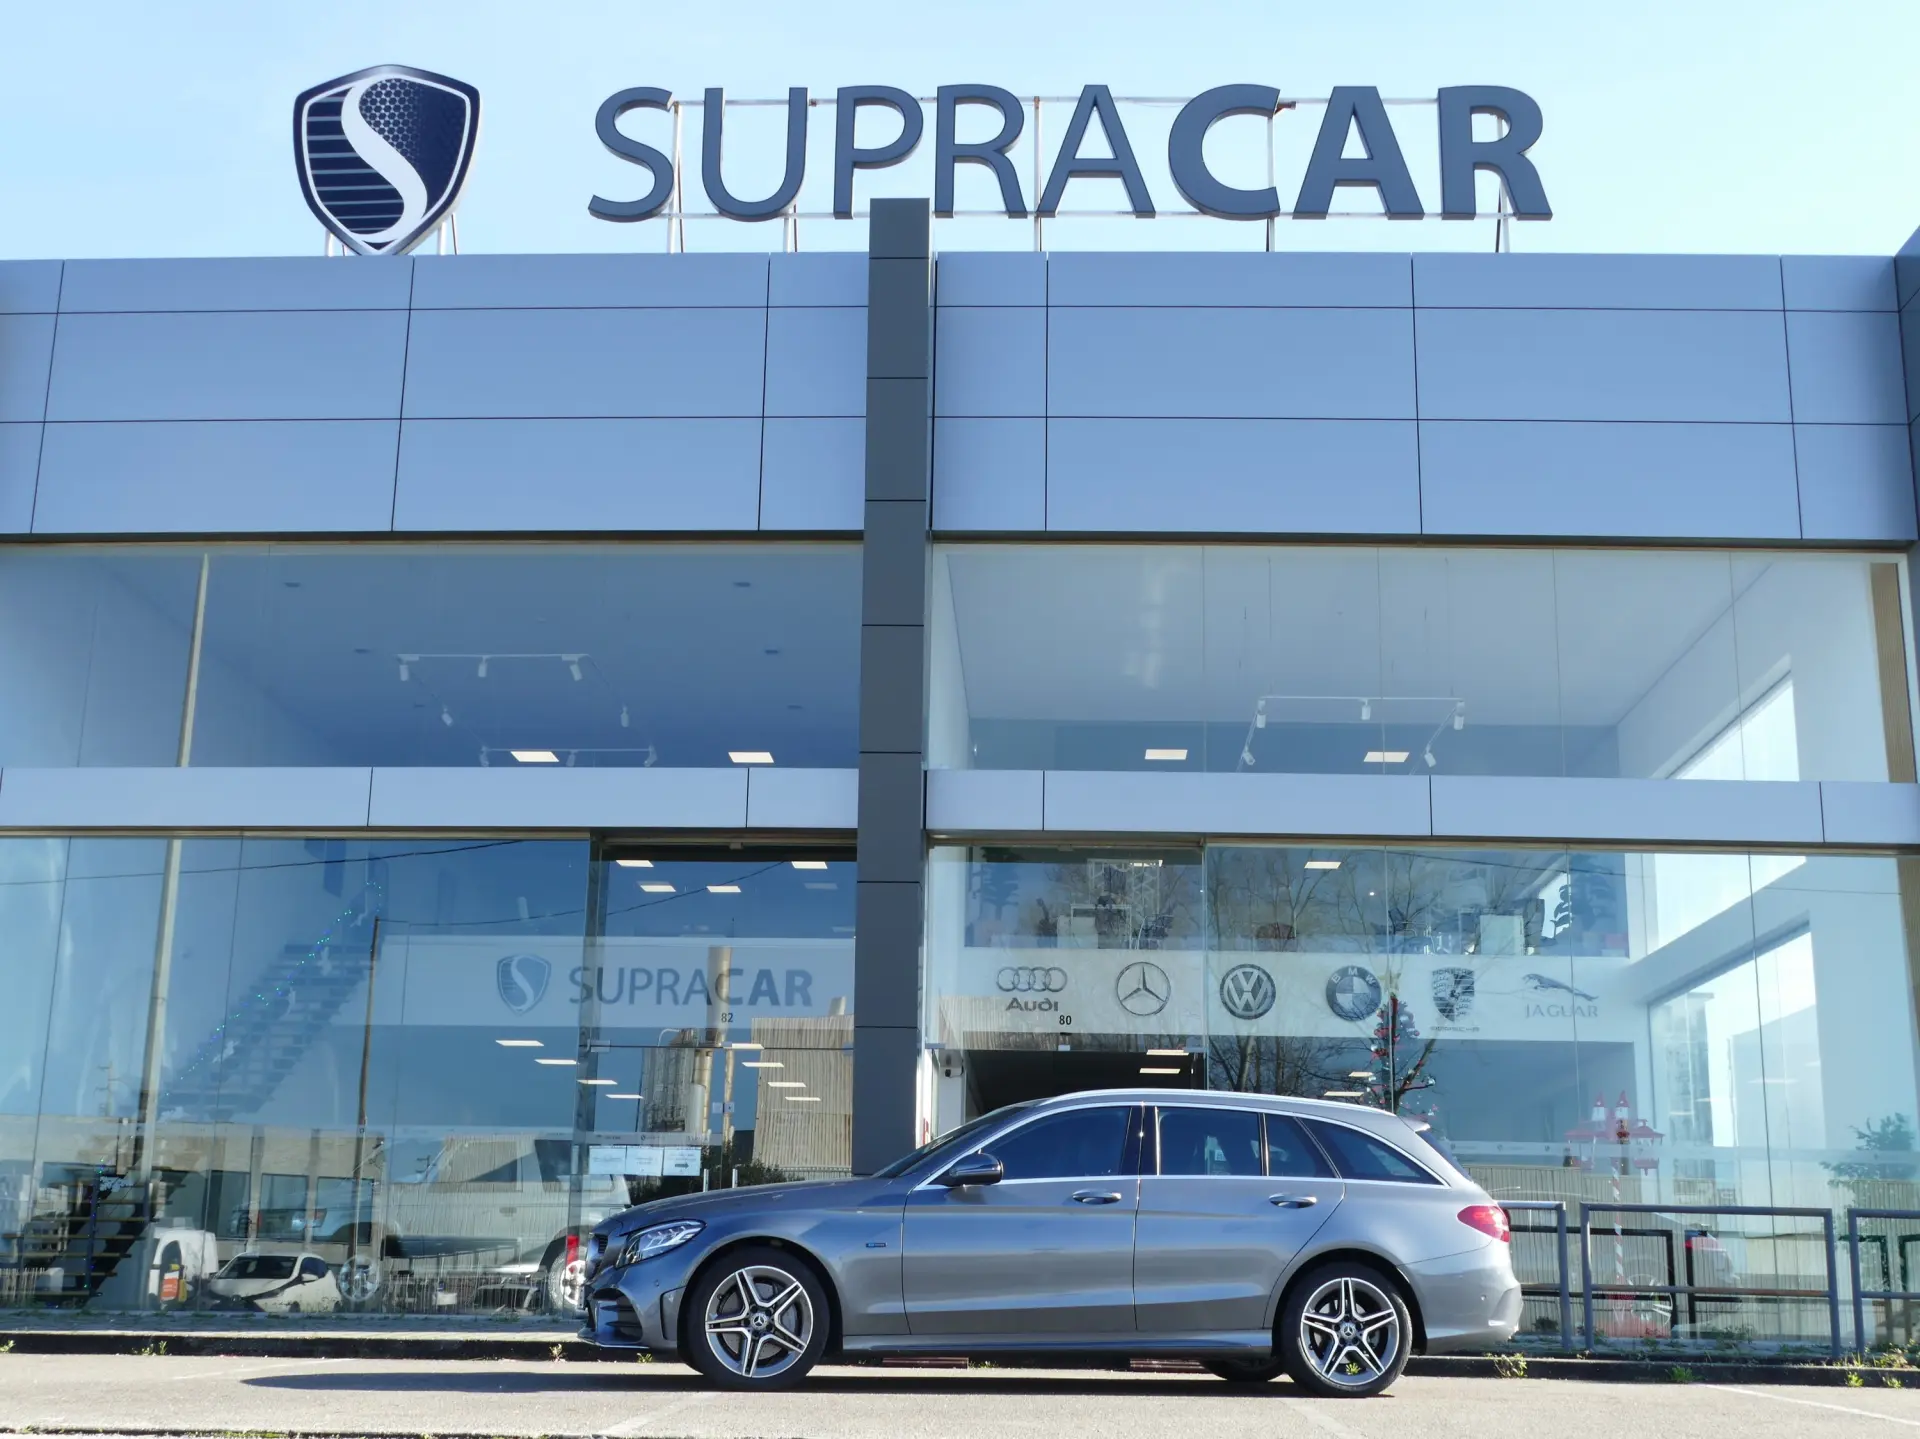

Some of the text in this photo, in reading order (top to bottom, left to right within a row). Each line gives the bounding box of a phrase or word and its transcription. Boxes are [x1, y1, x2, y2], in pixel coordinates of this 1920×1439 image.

[588, 84, 1552, 223] SUPRACAR
[1331, 967, 1377, 985] BMW
[569, 966, 813, 1007] SUPRACAR
[1005, 997, 1059, 1012] Audi
[1525, 1003, 1598, 1019] JAGUAR
[720, 1012, 734, 1024] 82
[1058, 1014, 1072, 1026] 80
